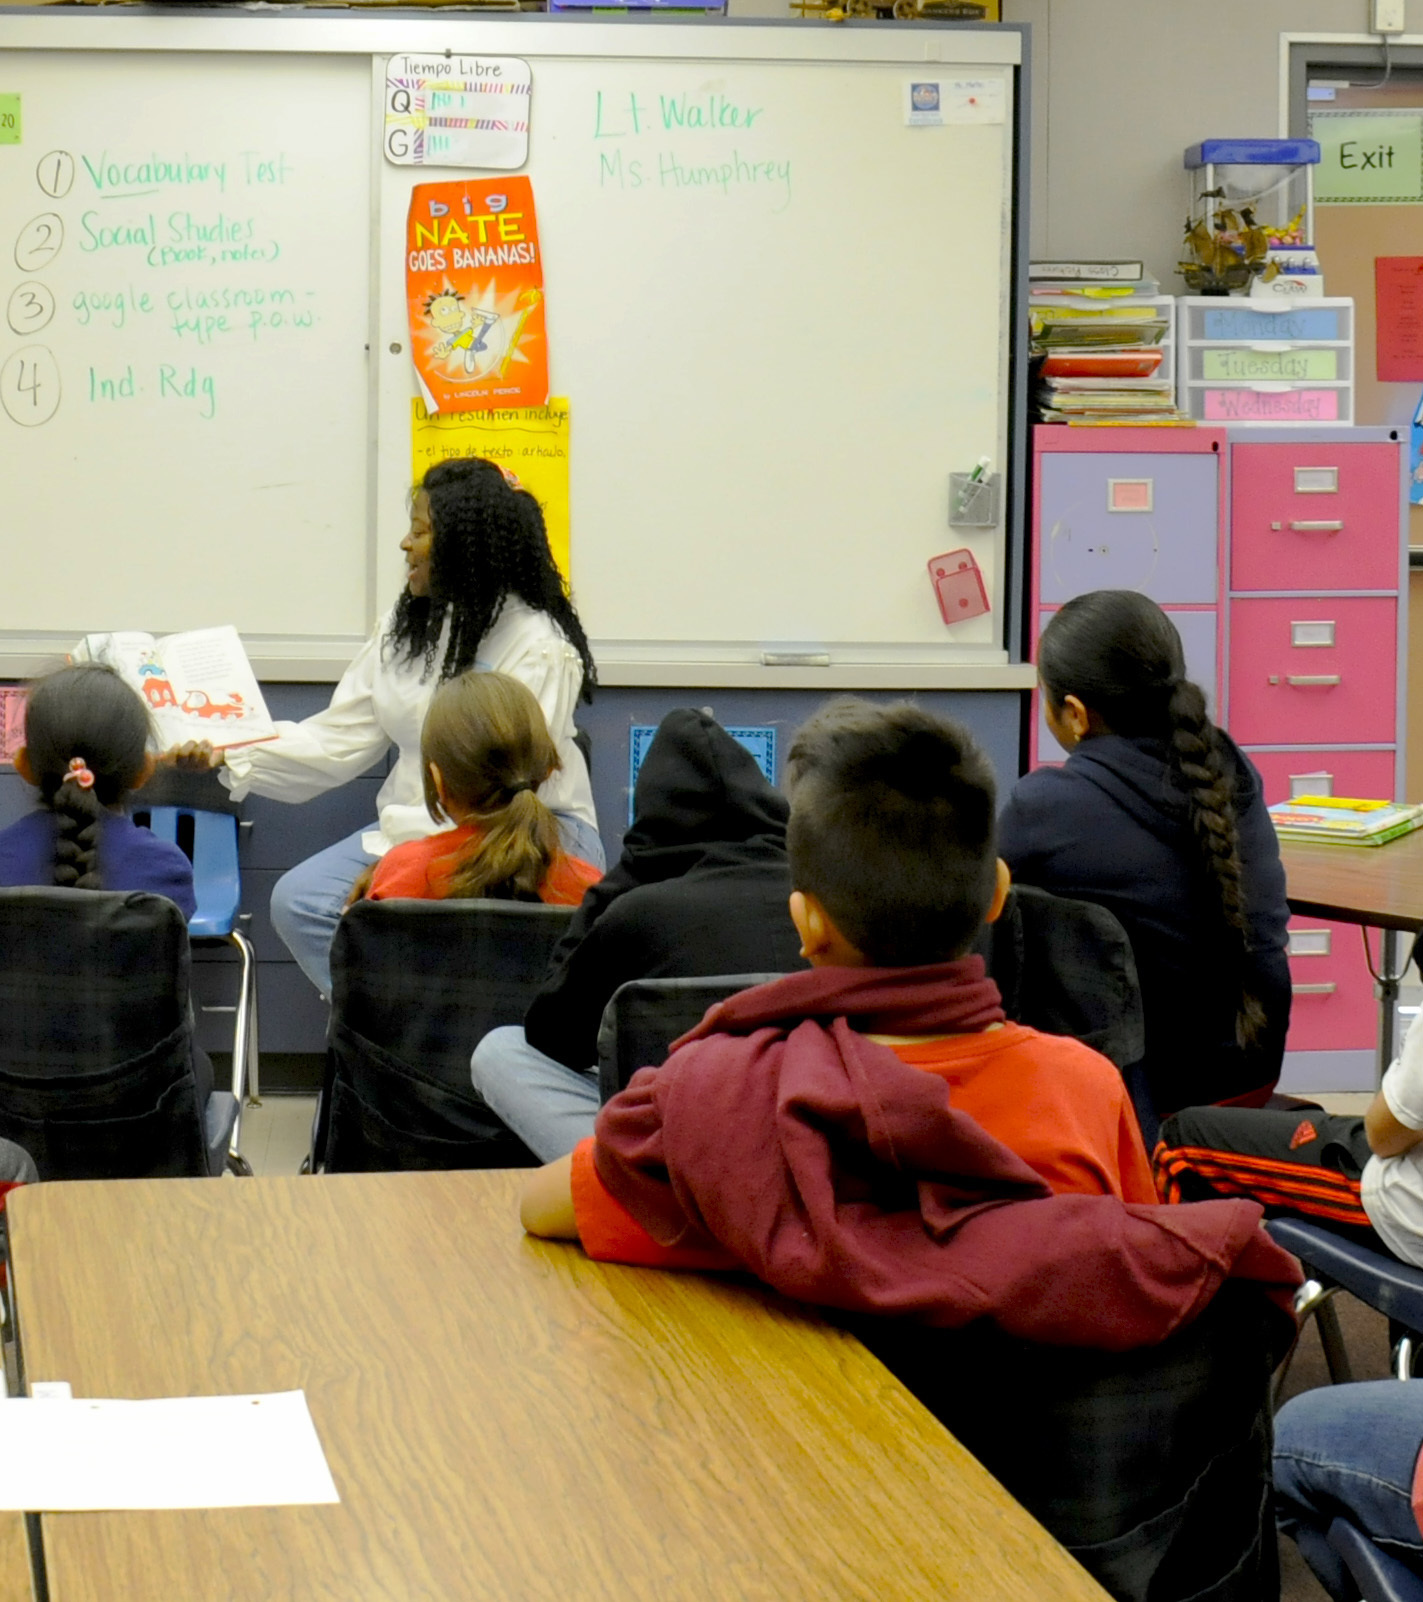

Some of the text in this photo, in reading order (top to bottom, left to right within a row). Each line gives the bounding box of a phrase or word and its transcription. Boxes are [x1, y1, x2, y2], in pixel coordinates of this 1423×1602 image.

[402, 56, 502, 78] Tiempo Libre
[391, 89, 411, 114] Q
[659, 91, 764, 130] Walker
[388, 129, 409, 157] G
[1340, 141, 1394, 171] Exit
[81, 151, 227, 193] Vocabulary
[239, 151, 295, 185] Test
[659, 149, 791, 214] Humphrey
[428, 193, 508, 217] big
[28, 210, 255, 255] 2 Social Studies
[415, 212, 526, 248] NATE
[409, 242, 535, 272] GOES BANANAS!
[19, 282, 294, 328] 3 google classroom
[172, 312, 230, 344] type
[1214, 312, 1306, 337] Monday
[1218, 352, 1308, 379] Tuesday
[17, 360, 41, 407] 4
[160, 364, 215, 419] Rdg
[1219, 392, 1320, 418] Wednesday
